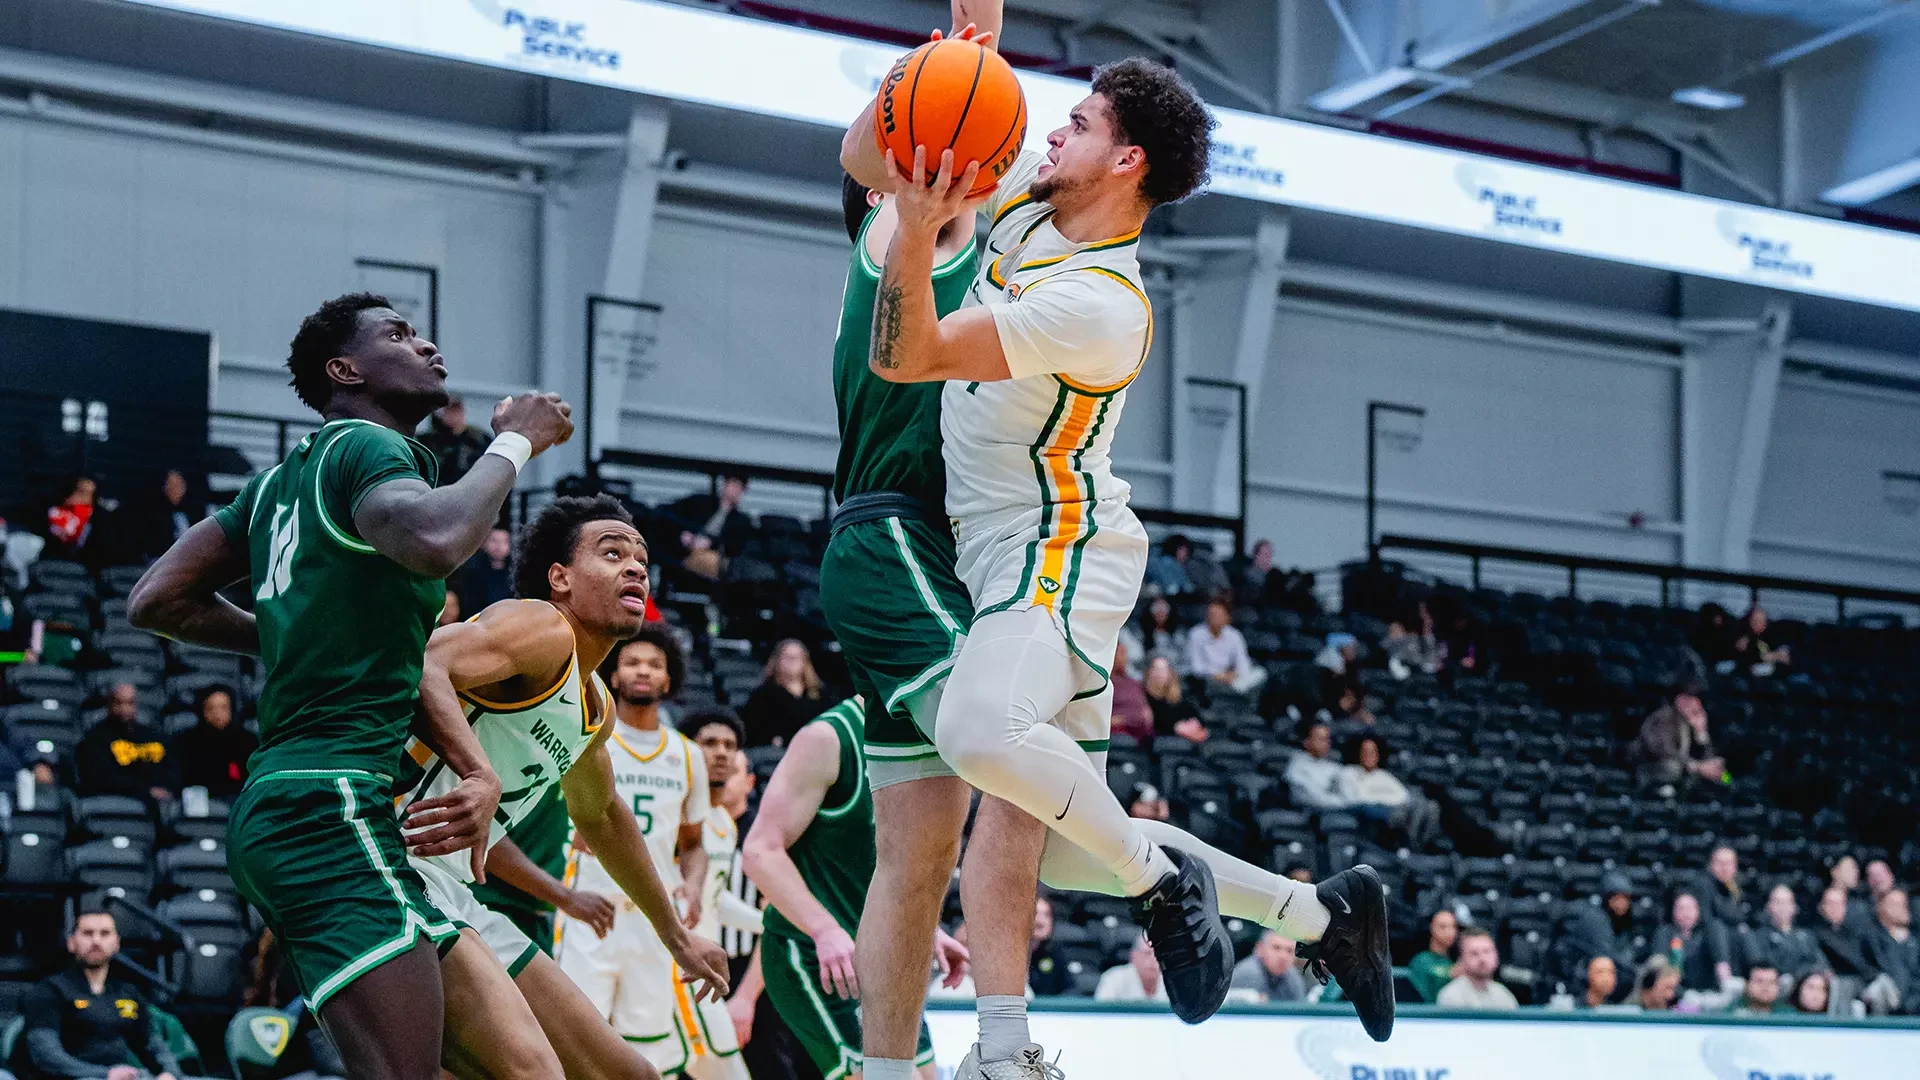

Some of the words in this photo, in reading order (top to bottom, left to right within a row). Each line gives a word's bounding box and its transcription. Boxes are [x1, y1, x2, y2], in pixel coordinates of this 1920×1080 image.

[503, 9, 585, 41] PUBLIC
[529, 718, 573, 777] WARRIO
[615, 774, 682, 791] ARRIORS
[633, 794, 654, 835] 5
